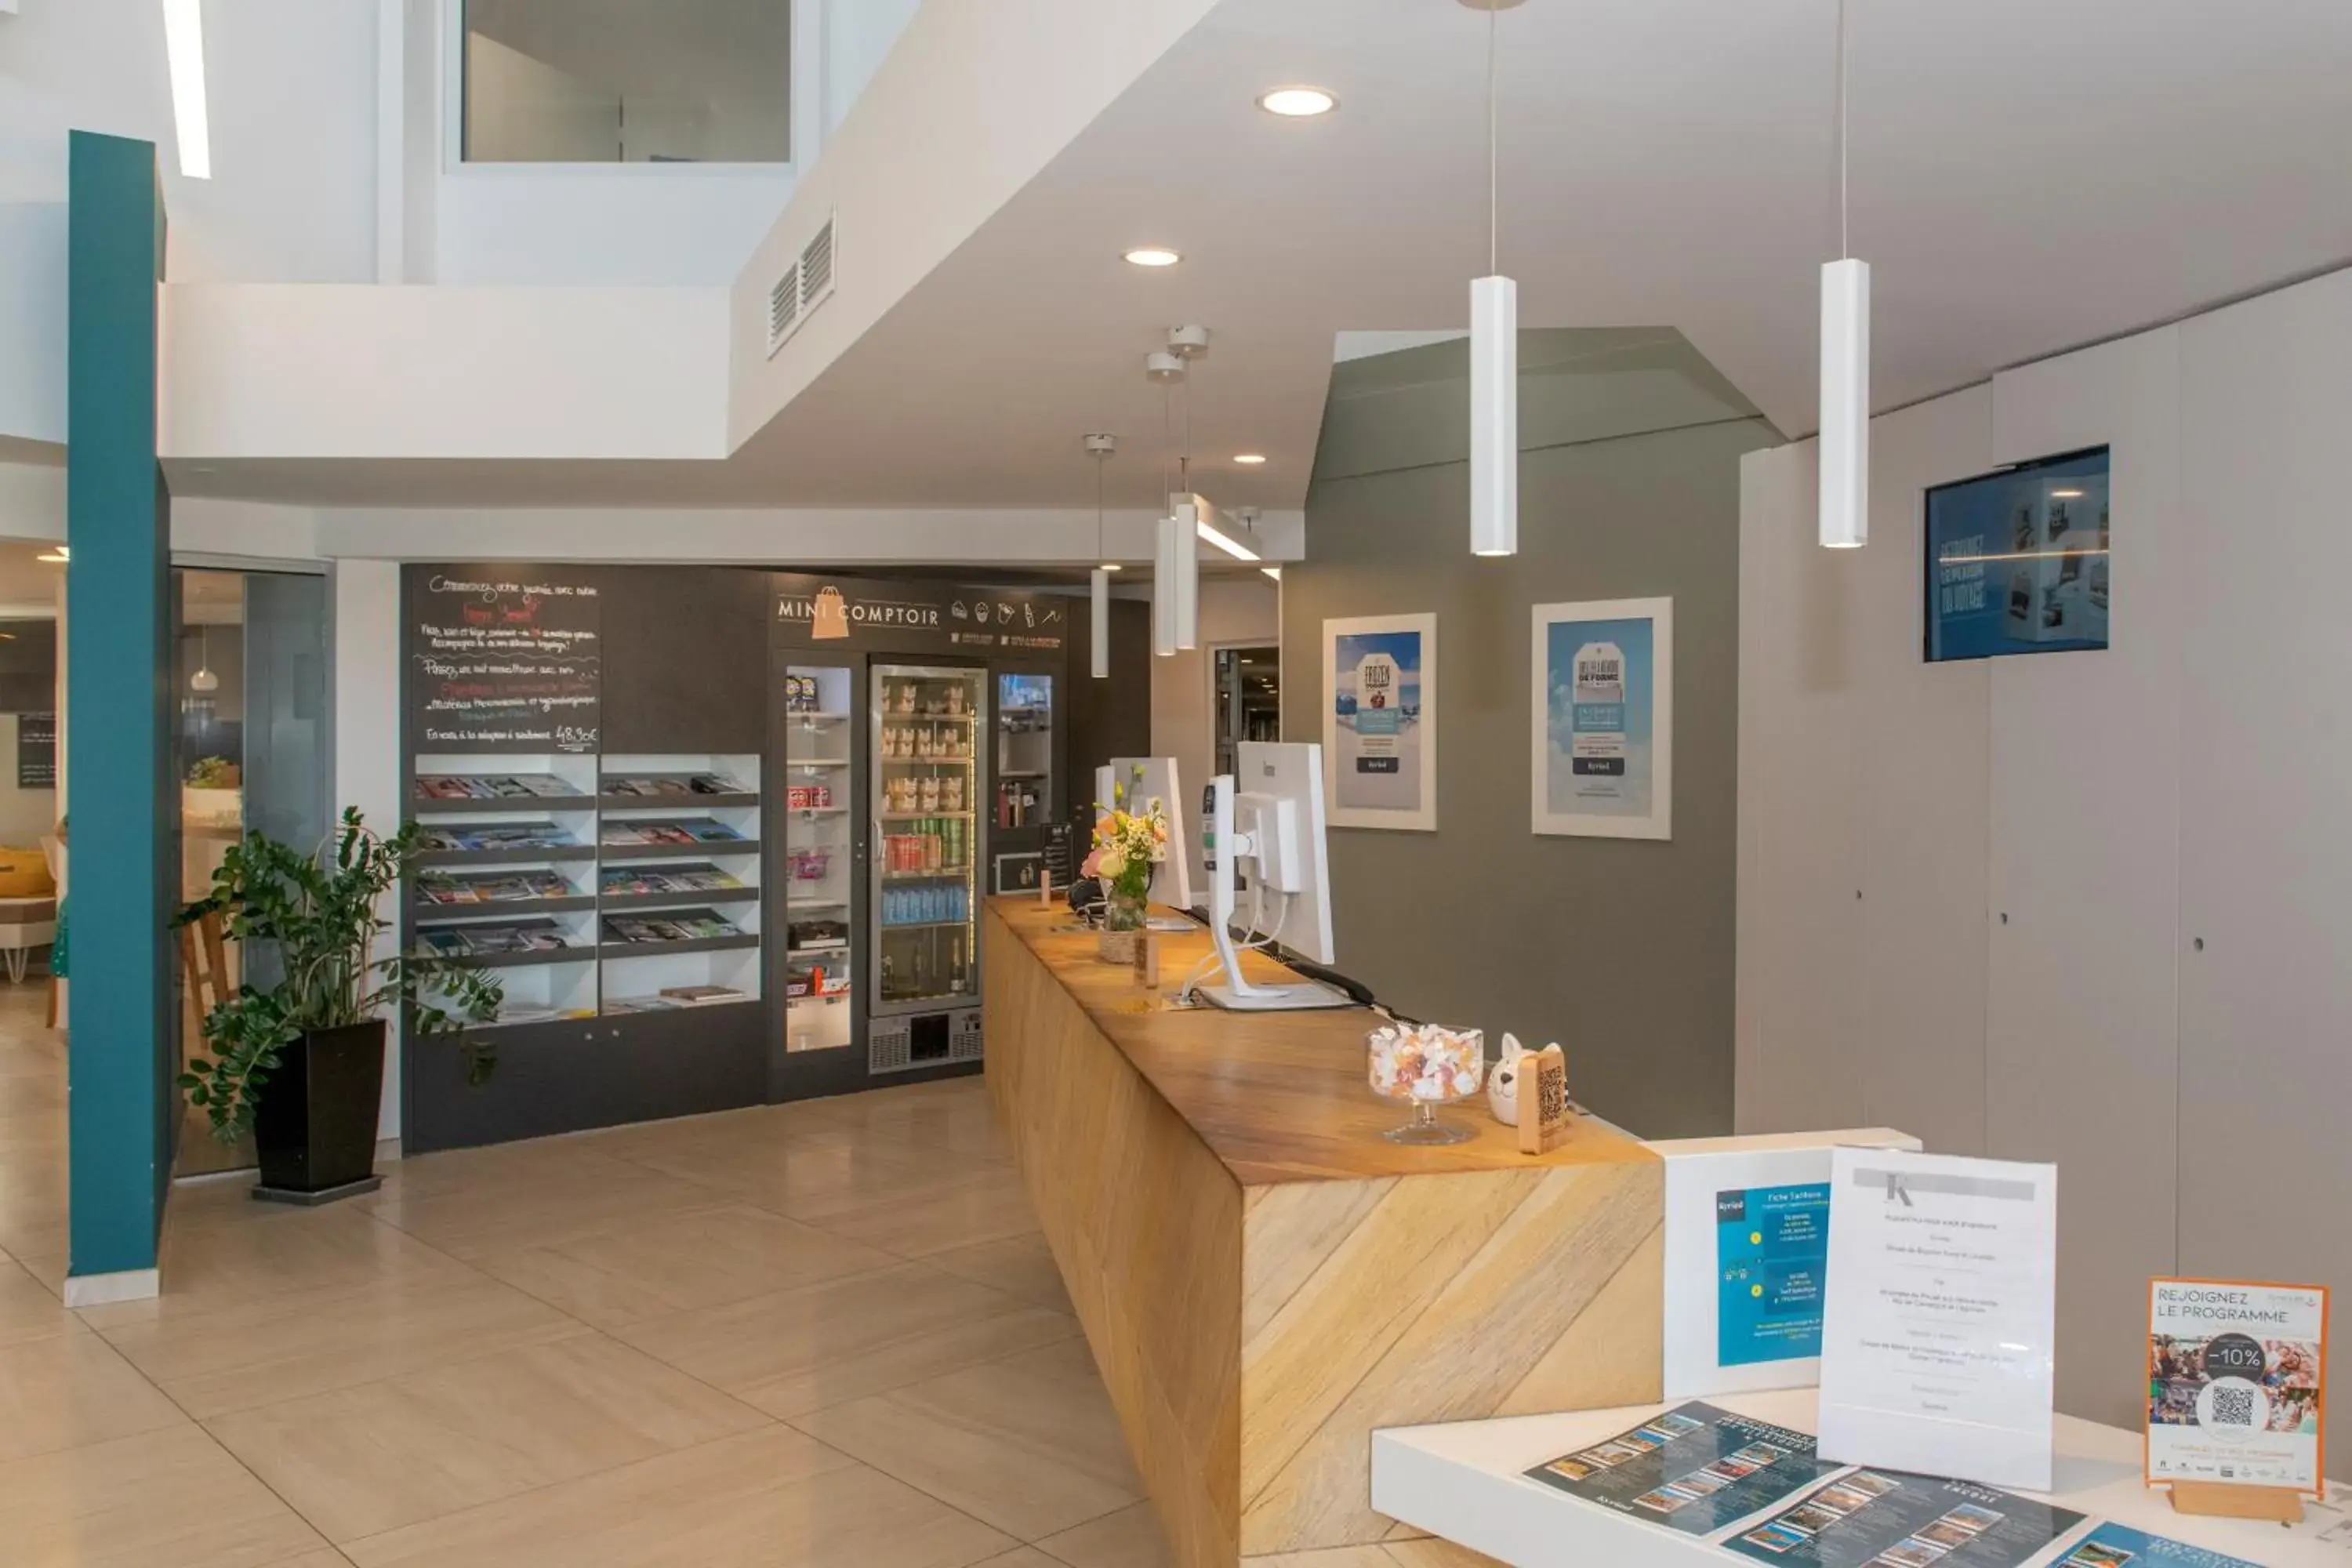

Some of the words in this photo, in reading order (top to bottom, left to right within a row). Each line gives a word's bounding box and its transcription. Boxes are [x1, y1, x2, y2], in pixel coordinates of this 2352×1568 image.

[779, 601, 826, 619] MINI
[838, 604, 938, 626] COMPTOIR
[1719, 1200, 1744, 1211] Kyriad
[2158, 1288, 2249, 1305] REJOIGNEZ
[2158, 1305, 2177, 1317] LE
[2182, 1305, 2289, 1323] PROGRAMME
[2209, 1348, 2260, 1367] -10%
